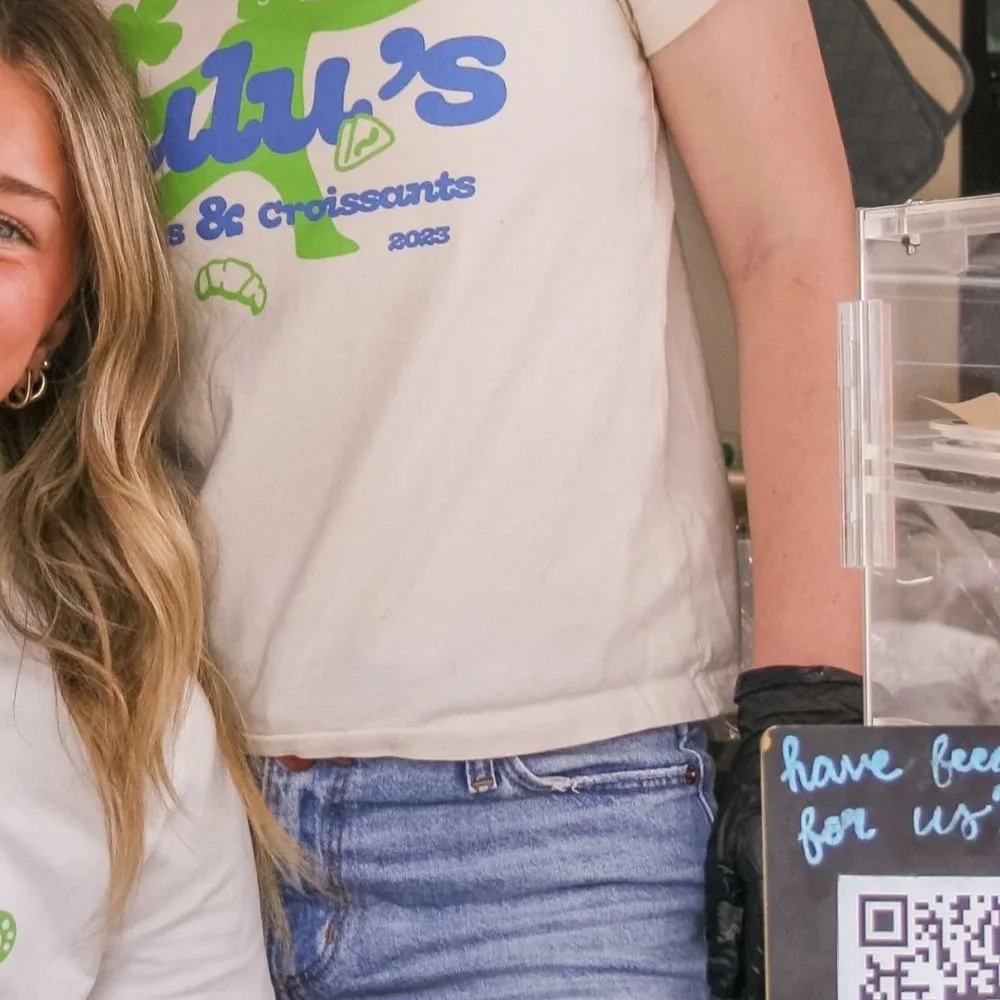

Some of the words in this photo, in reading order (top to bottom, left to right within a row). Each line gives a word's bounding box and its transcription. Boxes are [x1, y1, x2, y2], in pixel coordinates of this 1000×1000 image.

[150, 27, 507, 173] ulu's
[196, 196, 245, 240] &
[258, 172, 476, 228] croissants
[388, 226, 450, 251] 2023
[781, 735, 904, 793] have
[798, 806, 877, 865] for
